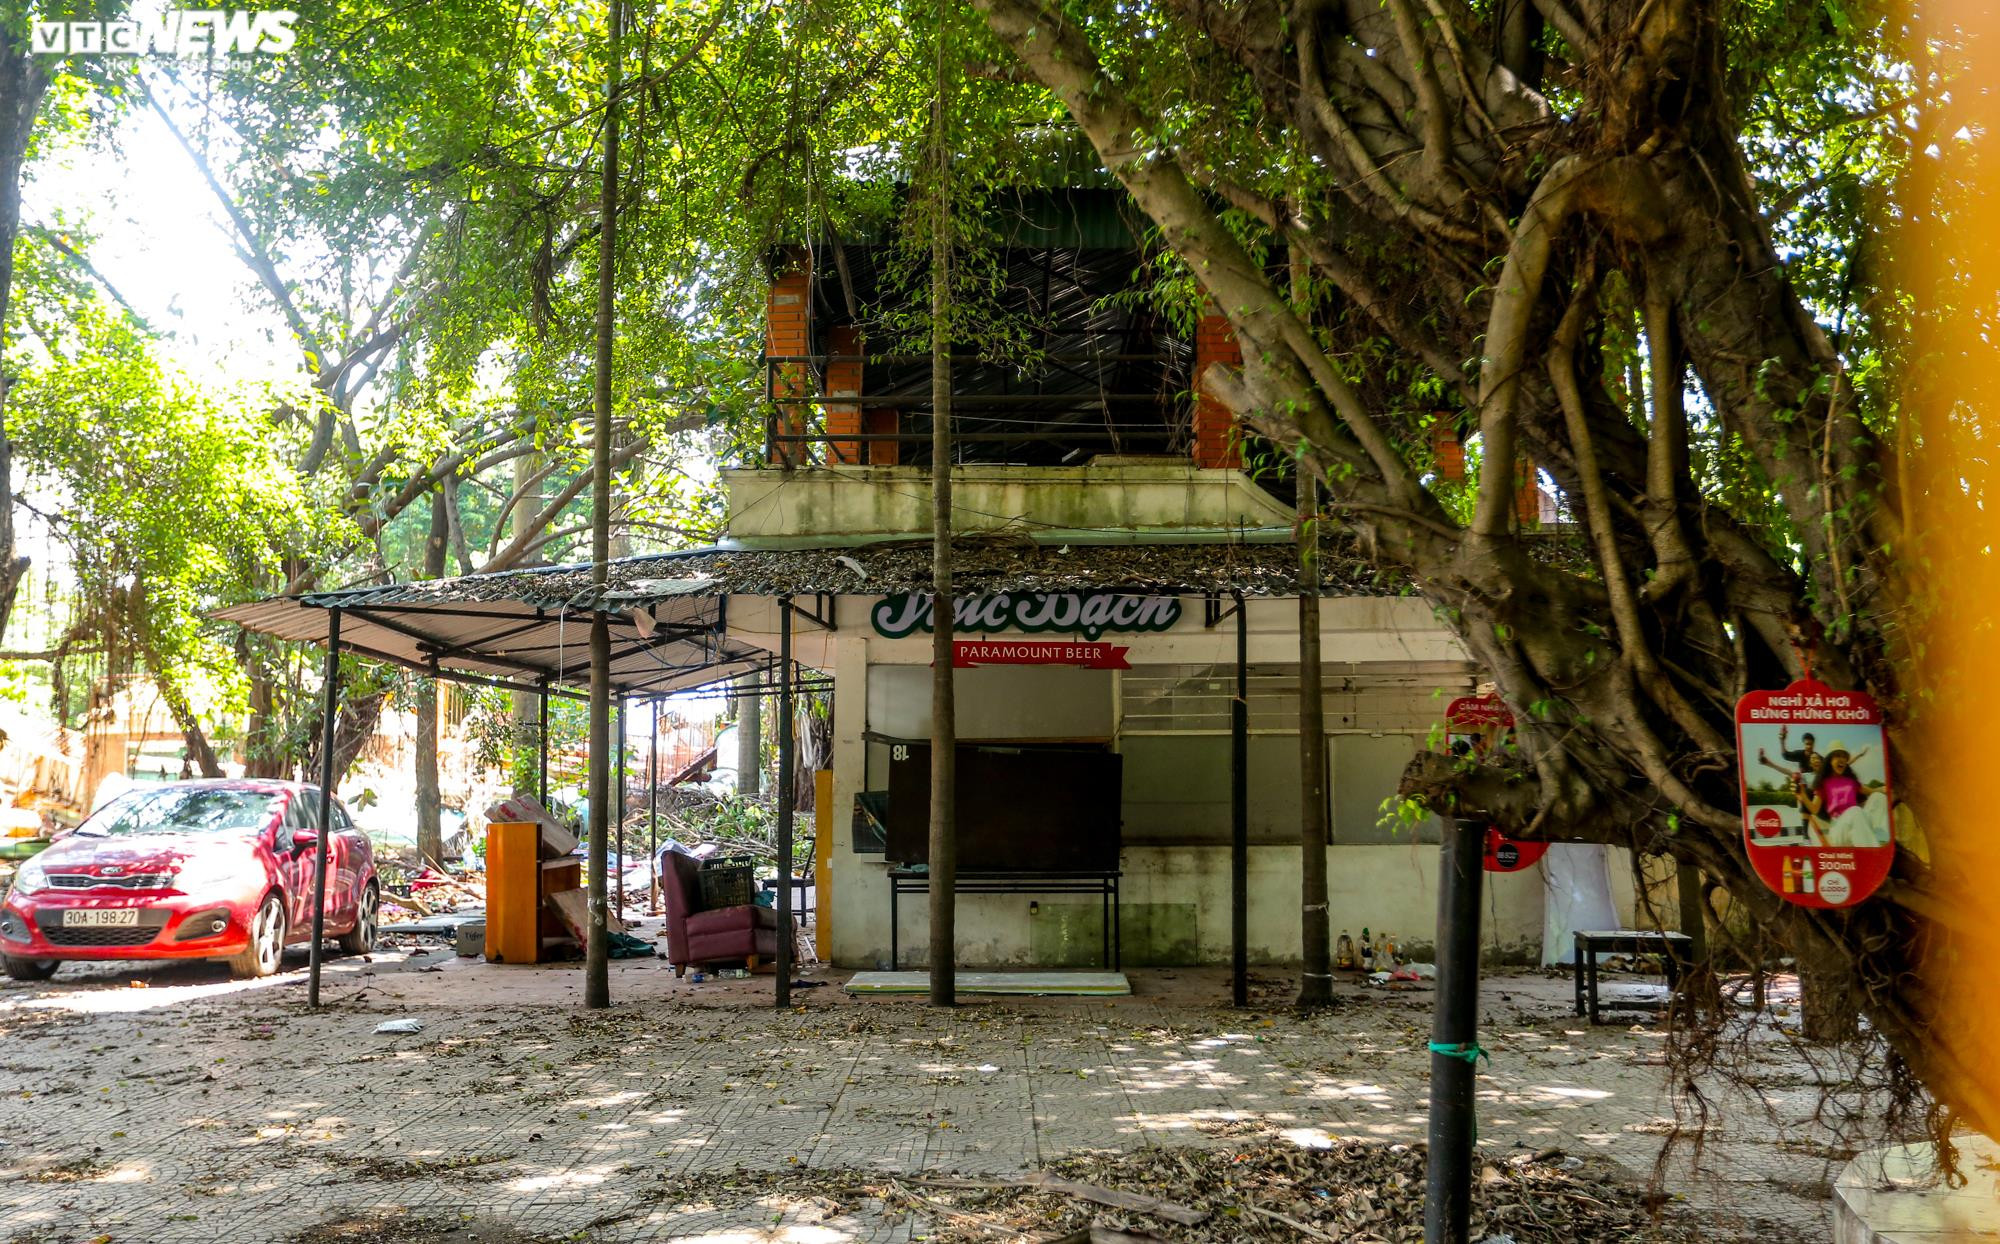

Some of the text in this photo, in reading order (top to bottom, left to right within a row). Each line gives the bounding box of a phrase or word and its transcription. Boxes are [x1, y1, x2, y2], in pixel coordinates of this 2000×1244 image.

[960, 646, 1102, 659] PARAMOUNT BEER
[1750, 707, 1790, 719] BỪNG
[1793, 707, 1833, 719] HỨNG
[1819, 861, 1856, 870] 300ml
